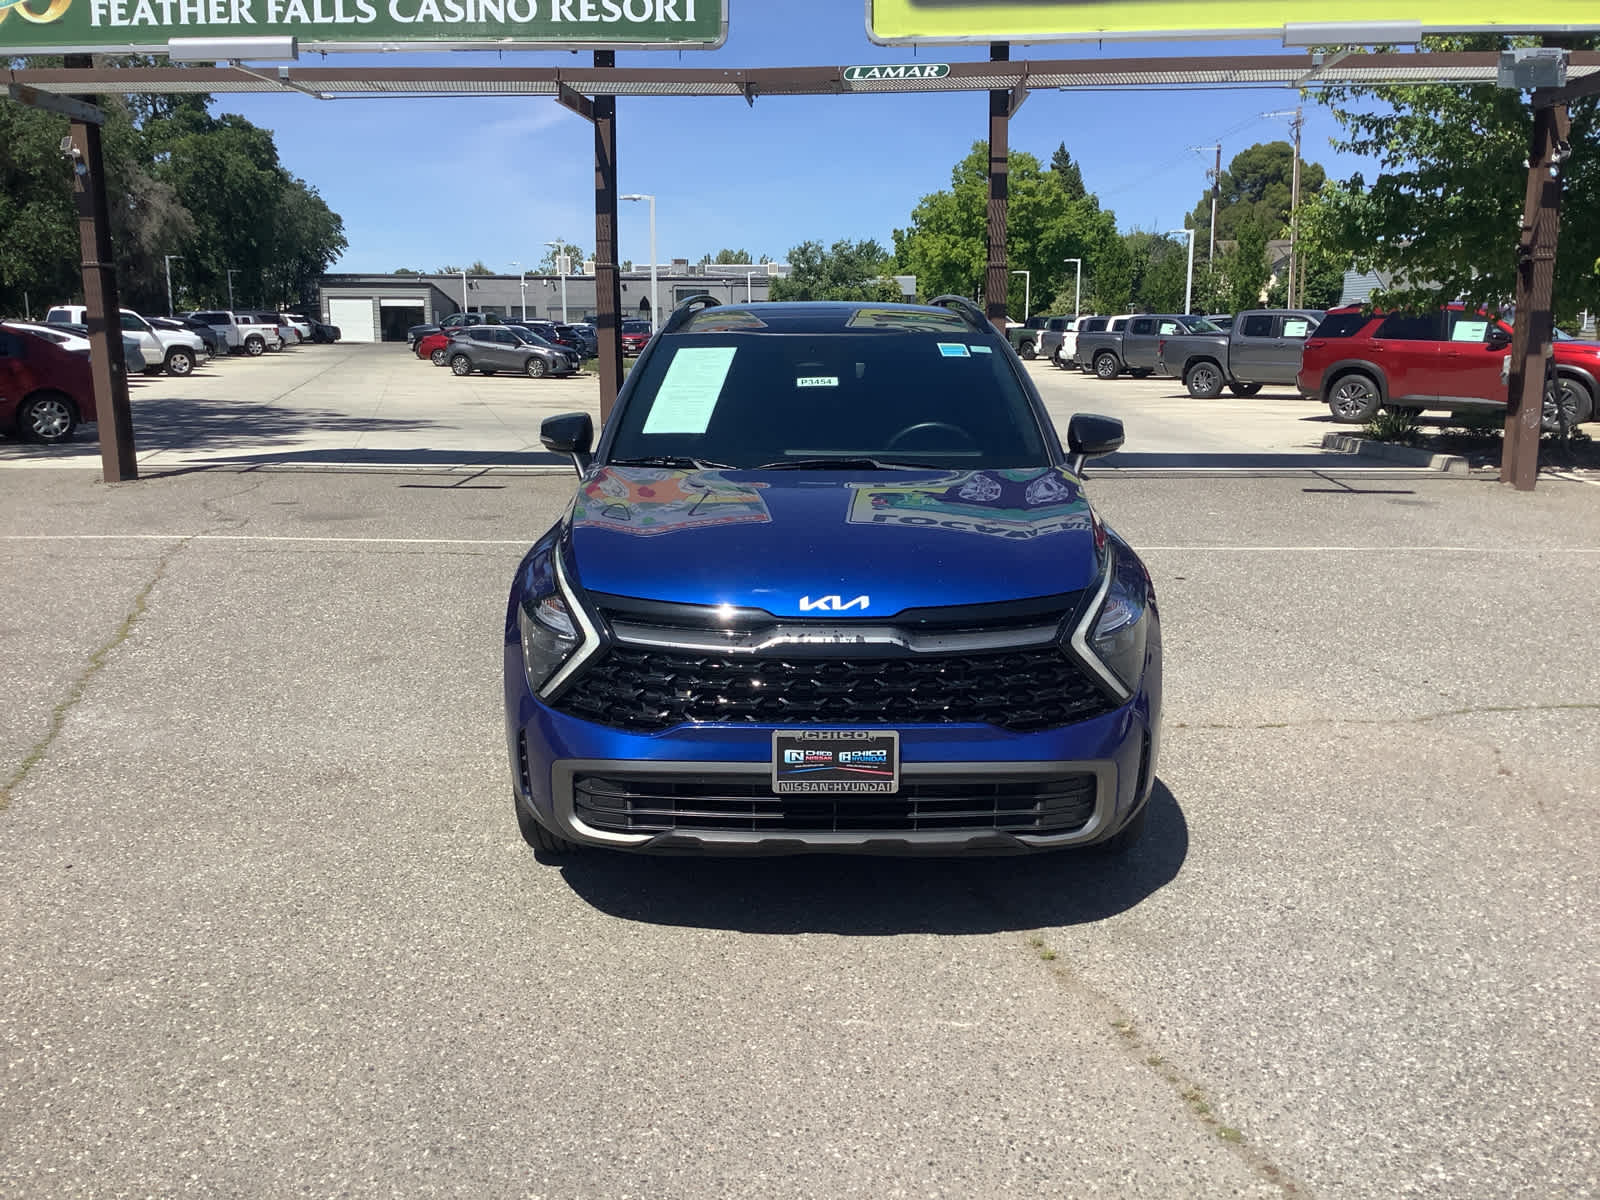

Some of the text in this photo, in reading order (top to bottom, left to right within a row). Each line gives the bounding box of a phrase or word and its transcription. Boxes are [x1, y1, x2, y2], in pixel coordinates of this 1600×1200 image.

[90, 0, 256, 26] FEATHER
[267, 0, 377, 25] FALLS
[388, 0, 538, 24] CASINO
[852, 65, 939, 79] LAMAR
[804, 731, 869, 740] CHICO
